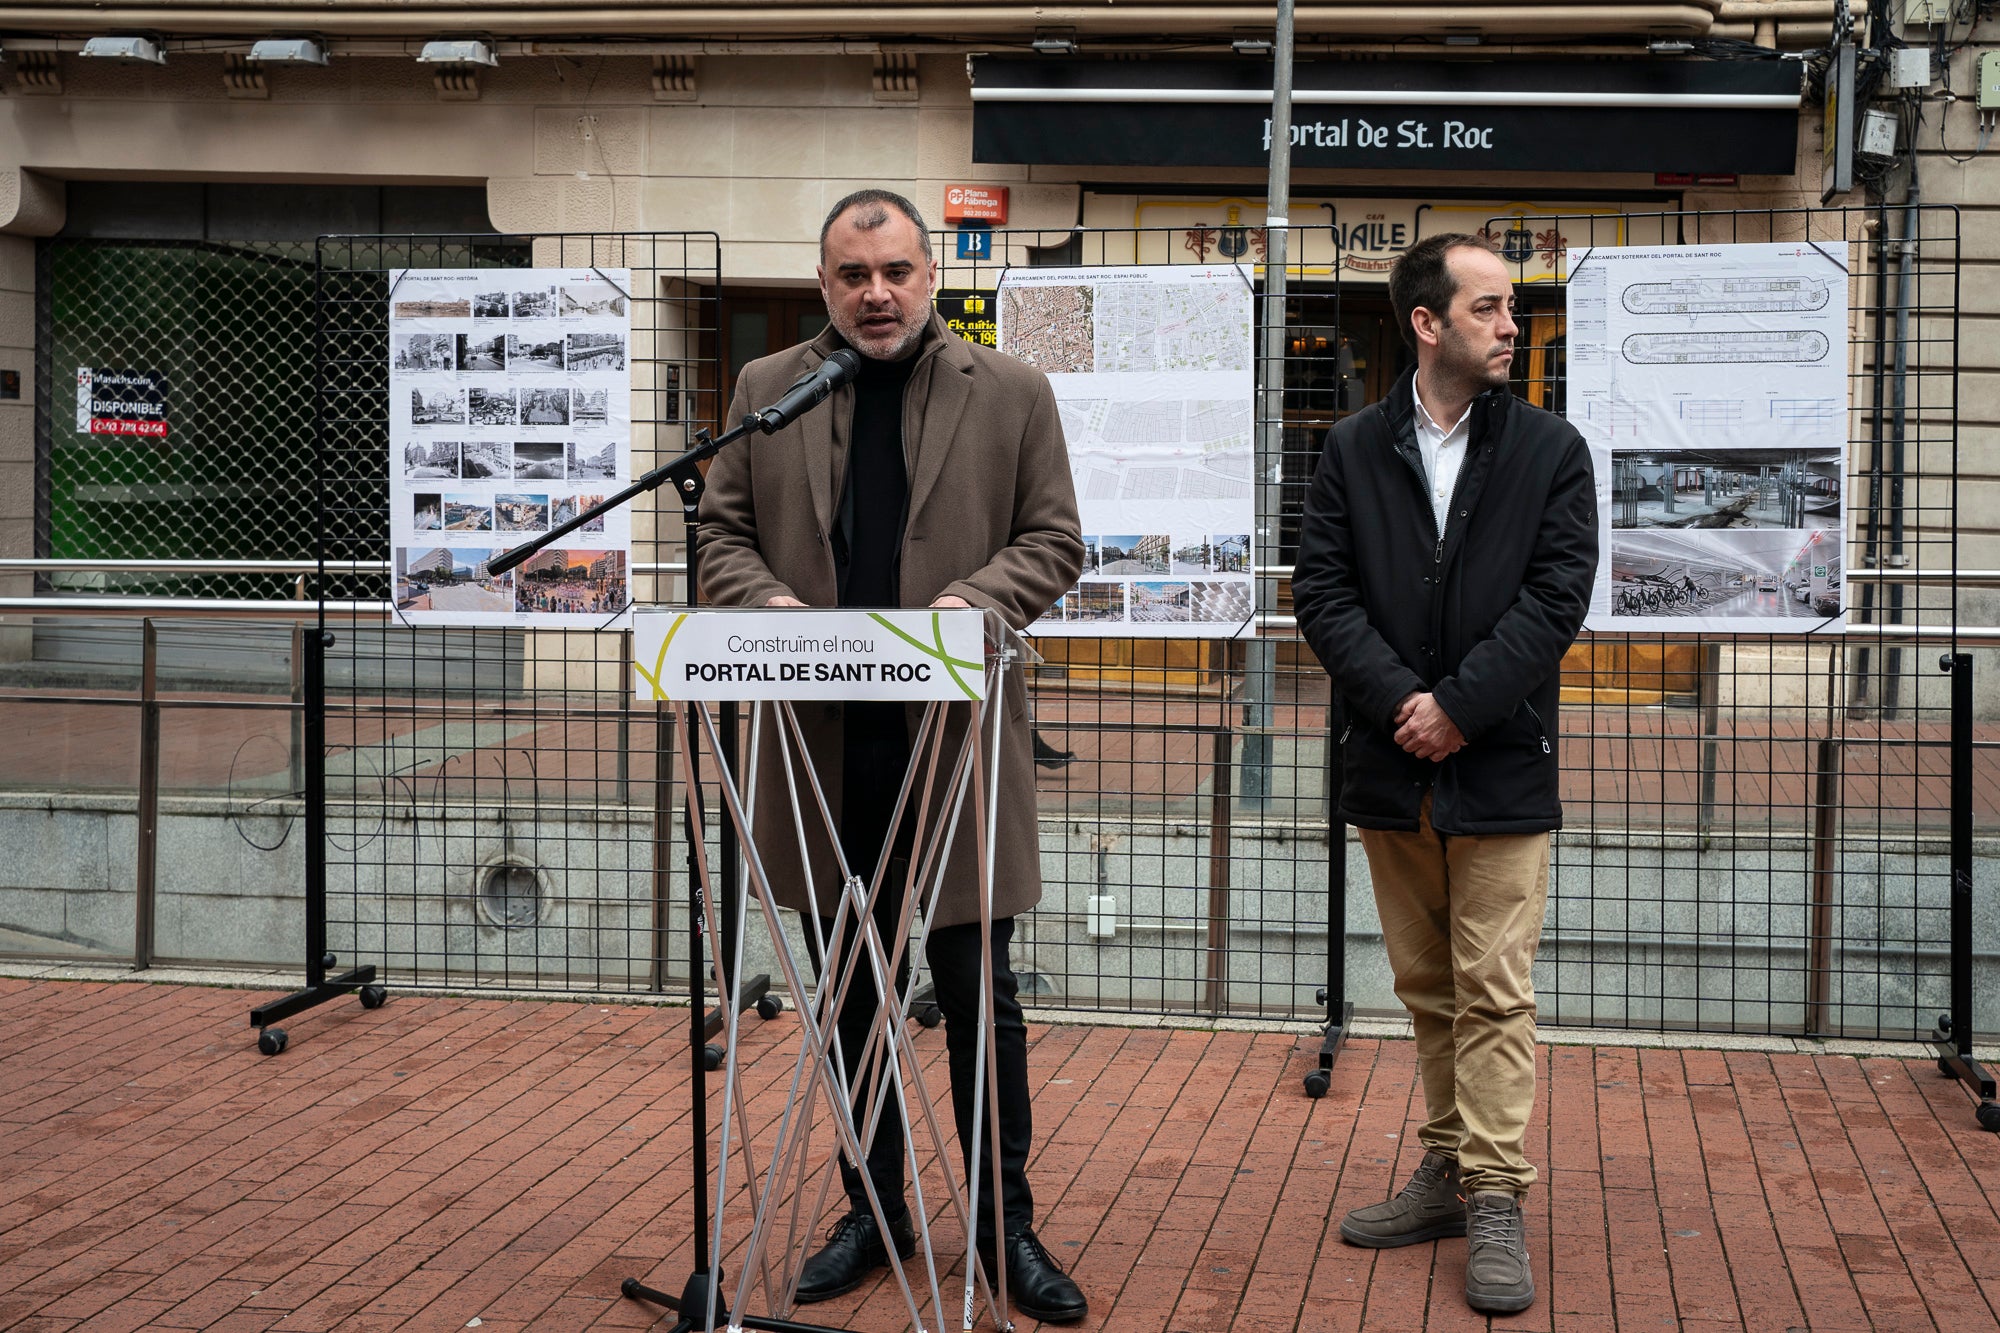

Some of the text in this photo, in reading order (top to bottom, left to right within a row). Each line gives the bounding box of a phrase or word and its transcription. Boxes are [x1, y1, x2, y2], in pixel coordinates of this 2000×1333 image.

[1357, 118, 1389, 149] de
[1396, 119, 1434, 149] St.
[1443, 120, 1494, 149] Roc
[964, 189, 988, 198] Plana
[967, 232, 982, 251] B
[1332, 222, 1408, 252] VALLE
[93, 400, 163, 415] DISPONIBLE
[727, 634, 874, 653] Construïm el nou
[685, 662, 931, 683] PORTAL DE SANT ROC
